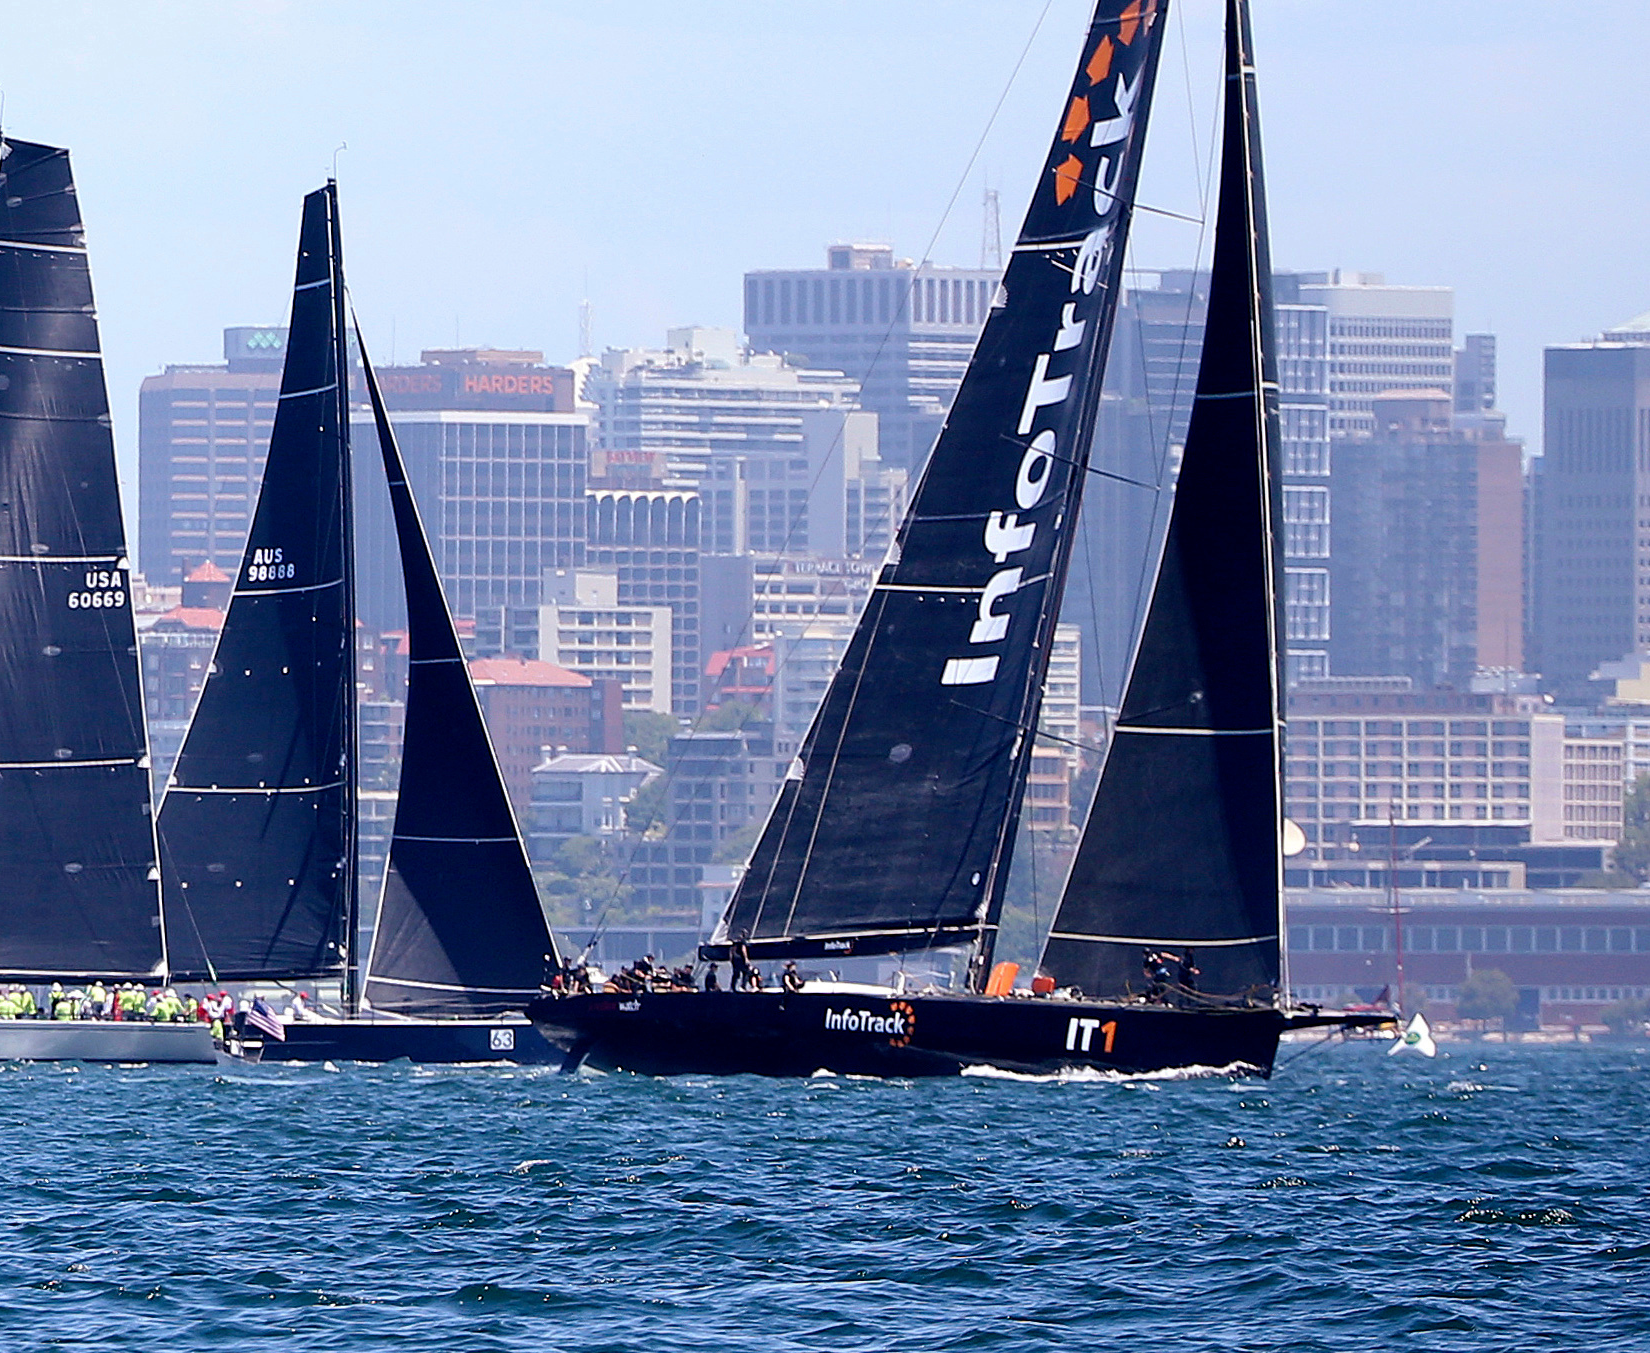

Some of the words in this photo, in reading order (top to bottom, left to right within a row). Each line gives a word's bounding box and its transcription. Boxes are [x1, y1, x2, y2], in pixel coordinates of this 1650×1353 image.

[464, 374, 554, 394] HARDERS
[941, 63, 1144, 686] InfoTrack
[253, 548, 283, 565] AUS
[86, 571, 122, 588] USA
[248, 563, 295, 582] 98888
[68, 591, 125, 609] 60669
[825, 1008, 905, 1034] InfoTrack
[492, 1030, 512, 1047] 63
[1066, 1017, 1117, 1053] IT1
